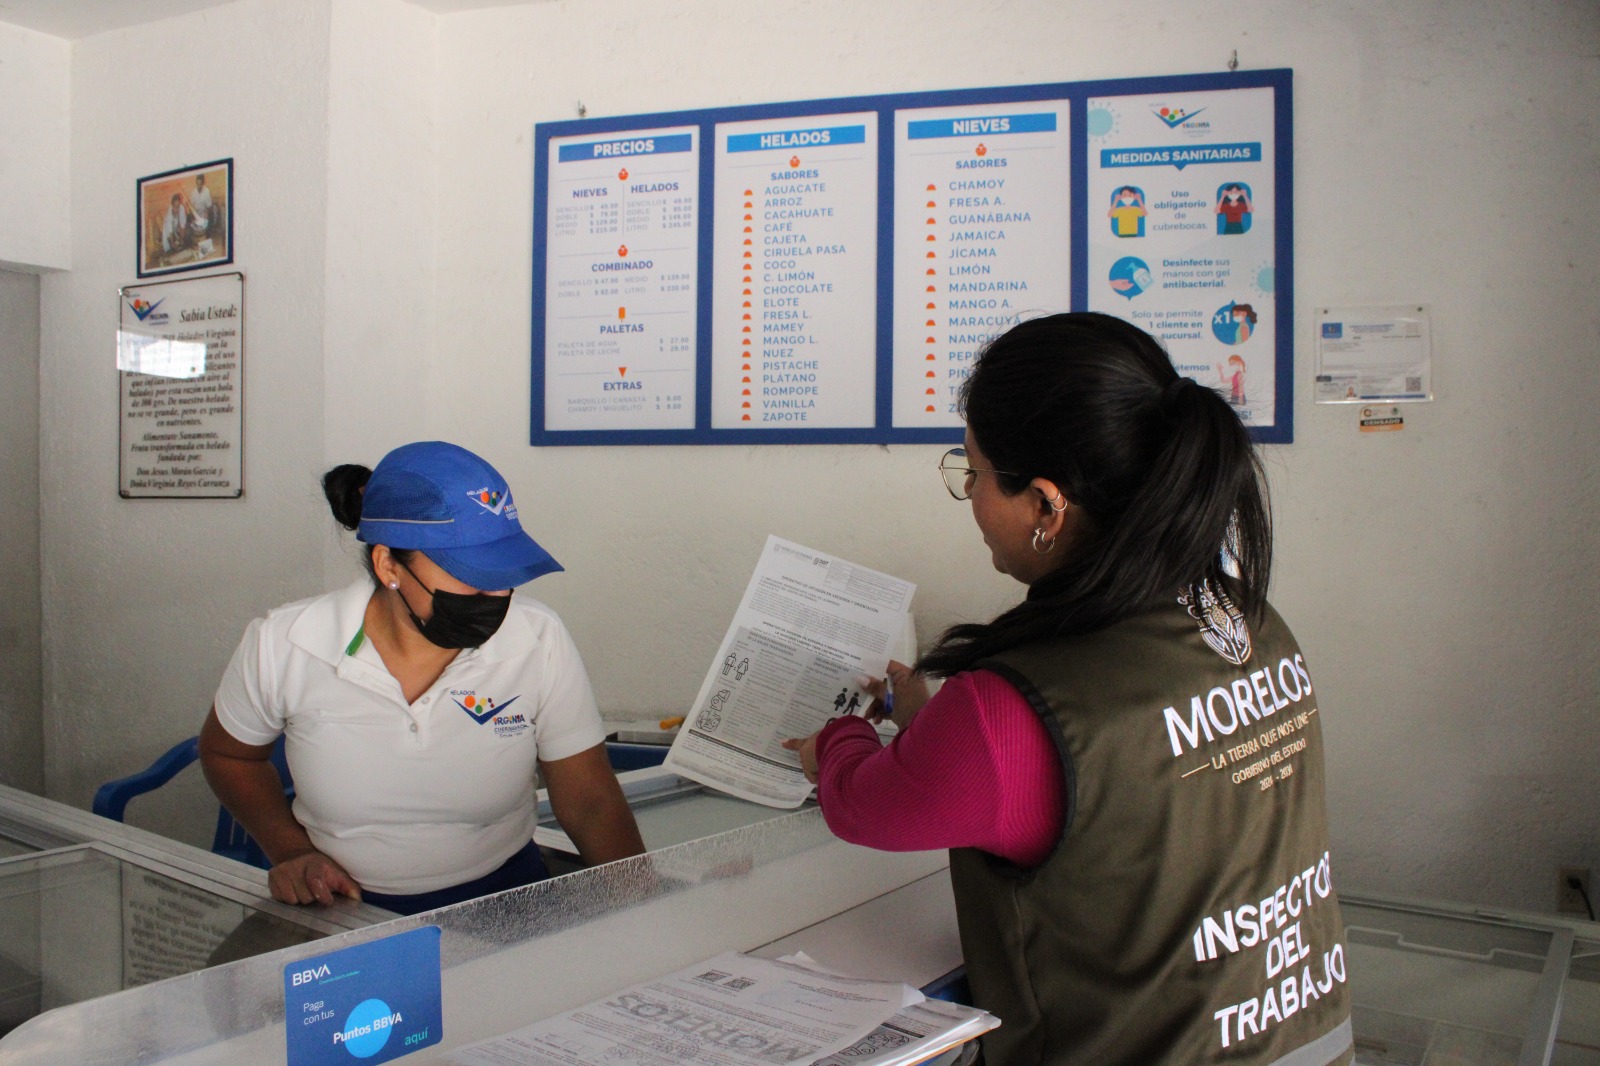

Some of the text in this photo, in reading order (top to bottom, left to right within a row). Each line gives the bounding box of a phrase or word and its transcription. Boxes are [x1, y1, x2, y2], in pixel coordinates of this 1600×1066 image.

[952, 117, 1010, 135] NIEVES
[760, 130, 831, 148] HELADOS
[593, 139, 655, 157] PRECIOS
[1111, 148, 1251, 164] MEDIDAS SANITARIAS
[955, 158, 1008, 169] SABORES
[770, 169, 819, 181] SABORES
[631, 182, 679, 194] HELADOS
[764, 183, 826, 195] AGUACATE
[949, 179, 1005, 191] CHAMOY
[572, 187, 608, 199] NIEVES
[1171, 190, 1189, 198] Uso
[764, 197, 803, 208] ARROZ
[949, 197, 989, 208] FRESA
[1154, 201, 1207, 211] obligatorio
[764, 207, 834, 220] CACAHUATE
[949, 211, 1031, 225] GUANÁBANA
[1174, 211, 1186, 220] de
[764, 234, 807, 245] CAJETA
[949, 230, 1006, 242] JAMAICA
[764, 245, 846, 258] CIRUELA PASA
[949, 247, 997, 259] JÍCAMA
[591, 260, 653, 272] COMBINADO
[763, 260, 796, 270] COCO
[1162, 258, 1213, 267] Desinfecte
[949, 263, 991, 276] LIMÓN
[1196, 270, 1213, 278] con
[1216, 269, 1230, 279] gel
[778, 271, 815, 282] LIMÓN
[763, 283, 833, 295] CHOCOLATE
[949, 281, 1028, 293] MANDARINA
[763, 297, 799, 308] ELOTE
[949, 299, 997, 310] MANGO
[763, 310, 799, 320] FRESA
[1131, 310, 1203, 320] Solo se permite
[1214, 311, 1231, 326] x1
[600, 323, 644, 334] PALETAS
[763, 323, 804, 333] MAMEY
[1156, 320, 1189, 329] cliente
[1191, 321, 1203, 329] en
[763, 335, 806, 345] MANGO
[763, 348, 794, 358] NUEZ
[763, 360, 819, 371] PISTACHE
[763, 372, 816, 384] PLÁTANO
[603, 381, 642, 391] EXTRAS
[763, 386, 818, 396] ROMPOPE
[763, 399, 816, 409] VAINILLA
[763, 412, 808, 422] ZAPOTE
[1163, 653, 1313, 757] MORELOS
[1211, 712, 1309, 770] LA TIERRA QUE NOS UNE
[1231, 738, 1306, 784] GOBIERNO DEL ESTADO
[1193, 851, 1332, 962] INSPECTO
[1266, 920, 1310, 979] DEL
[292, 963, 331, 987] BBVA
[1214, 943, 1346, 1048] TRABAJO
[303, 1000, 324, 1013] Paga
[303, 1009, 335, 1026] con tus
[333, 1012, 403, 1045] Puntos BBVA
[404, 1027, 429, 1046] aquí
